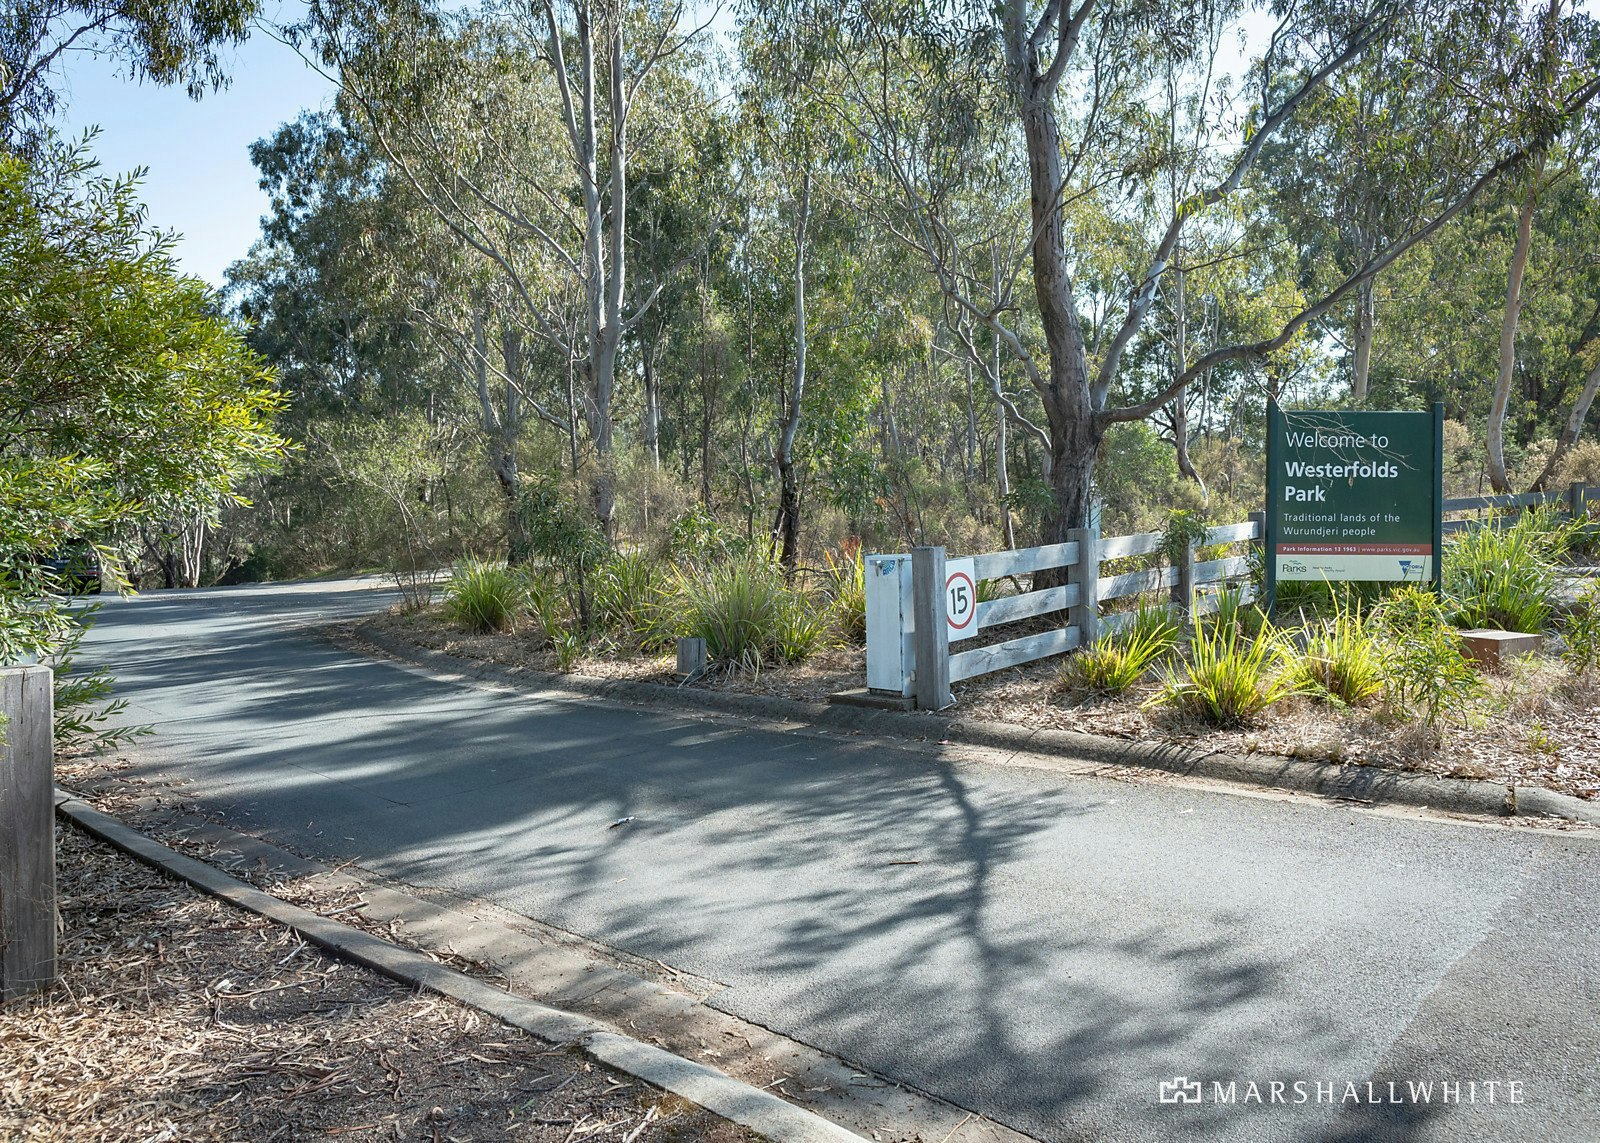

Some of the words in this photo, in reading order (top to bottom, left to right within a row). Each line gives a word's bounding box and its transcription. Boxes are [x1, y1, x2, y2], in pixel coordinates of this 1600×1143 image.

[1285, 431, 1366, 448] Welcome
[1371, 432, 1389, 448] to
[1285, 461, 1399, 478] Westerfolds
[1285, 485, 1326, 502] Park
[1284, 513, 1336, 522] Traditional
[1340, 513, 1366, 522] lands
[1370, 513, 1381, 522] of
[1384, 513, 1401, 523] the
[1283, 526, 1339, 537] Wurundjeri
[1342, 527, 1376, 536] people
[1282, 564, 1307, 572] Parks
[950, 586, 968, 615] 15
